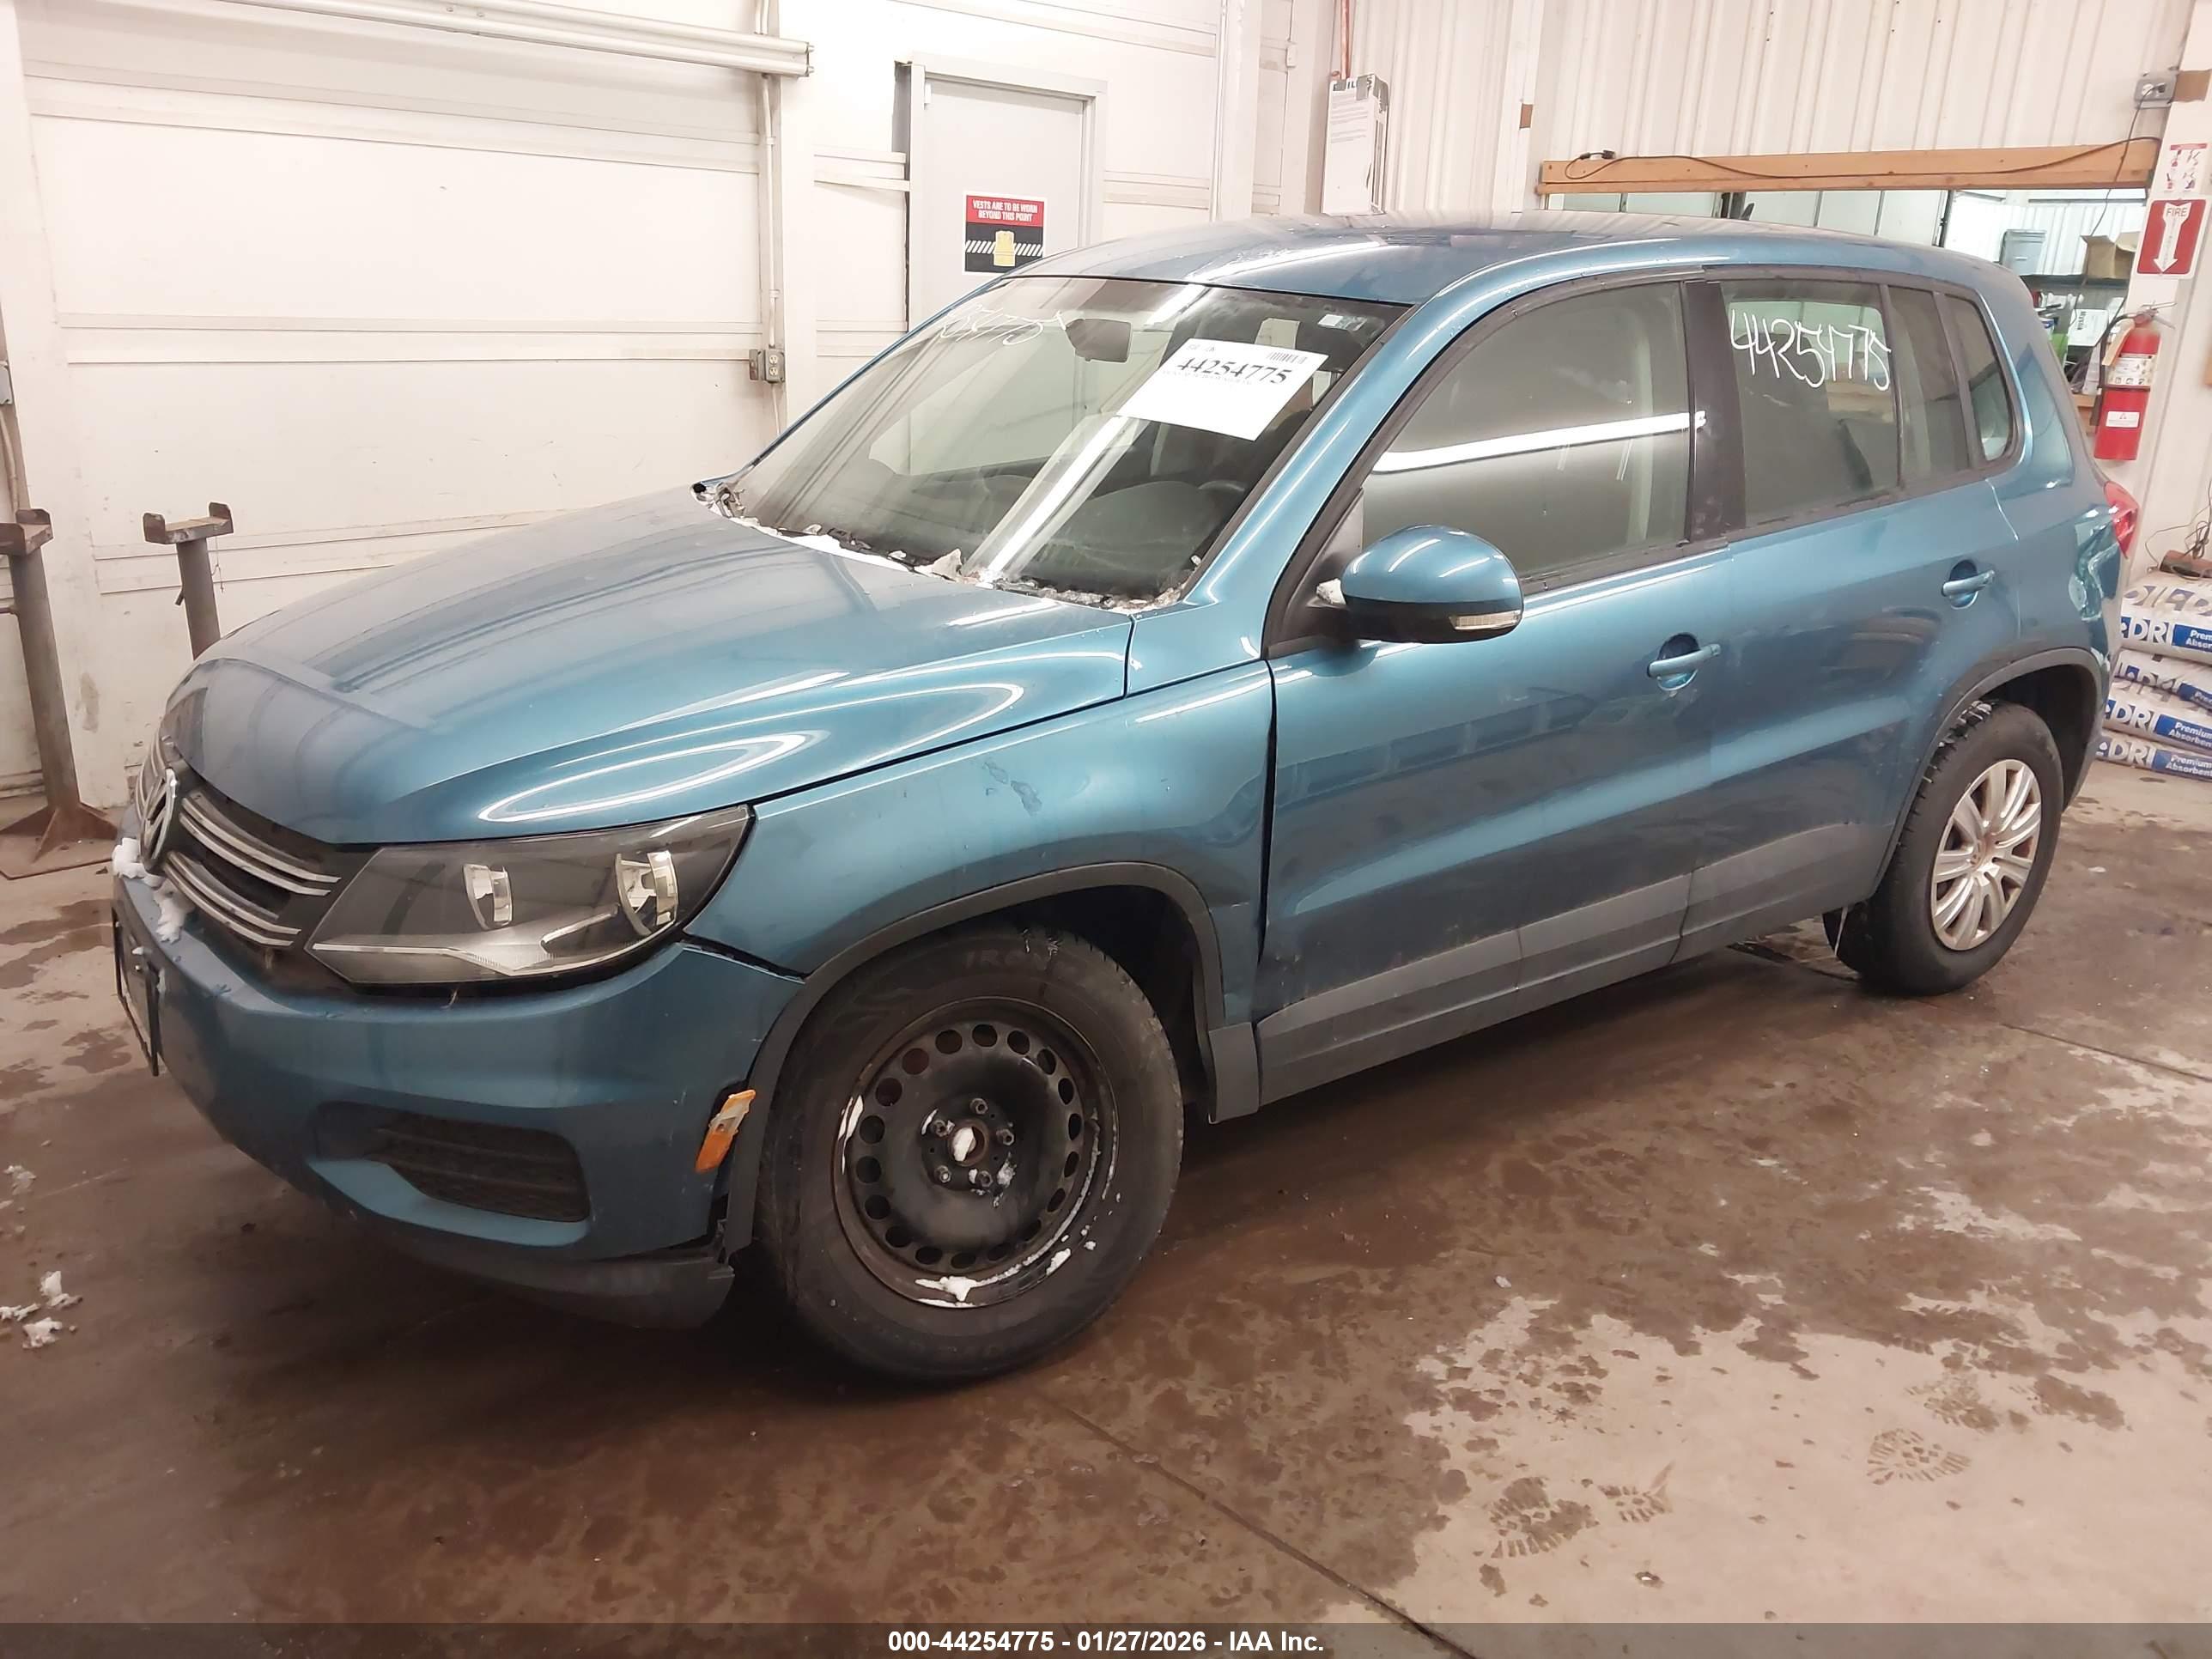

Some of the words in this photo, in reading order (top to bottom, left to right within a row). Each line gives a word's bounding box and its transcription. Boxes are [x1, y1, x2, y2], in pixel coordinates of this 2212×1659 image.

[973, 199, 992, 210] VESTS
[992, 201, 1004, 210] ARE
[1004, 202, 1012, 211] TO
[1012, 203, 1020, 212] BE
[1020, 204, 1038, 213] WORN
[978, 210, 1002, 220] BEYOND
[1002, 211, 1015, 221] THIS
[1015, 212, 1033, 222] POINT
[2166, 207, 2188, 217] FIRE
[1176, 356, 1292, 384] 44254775
[2112, 700, 2161, 733] DRI
[2109, 738, 2157, 769] DRI
